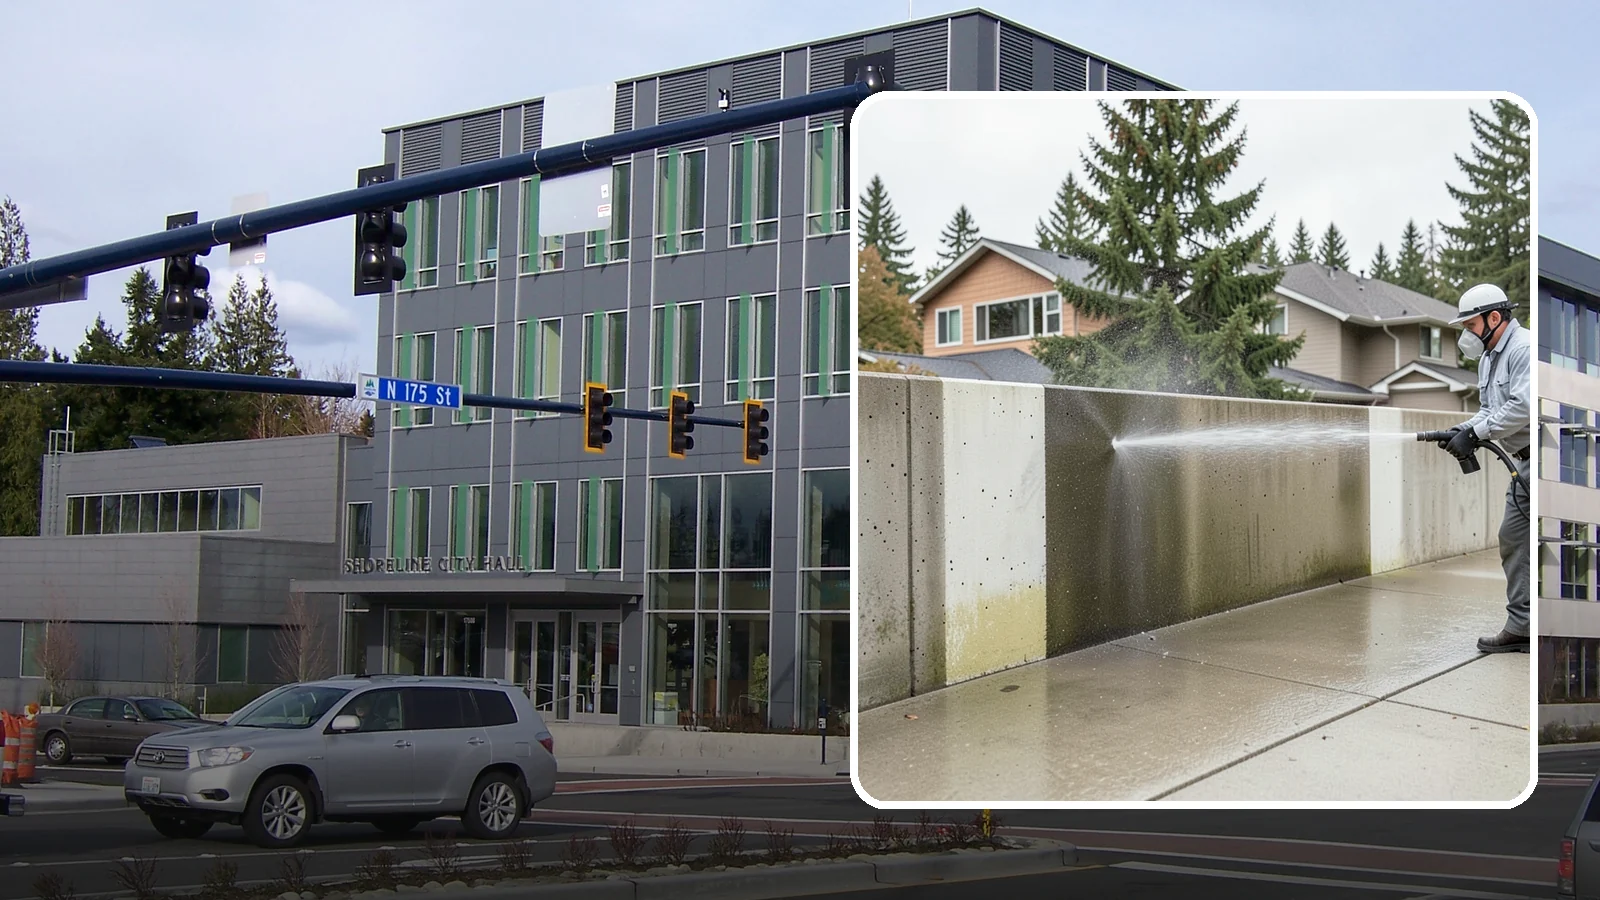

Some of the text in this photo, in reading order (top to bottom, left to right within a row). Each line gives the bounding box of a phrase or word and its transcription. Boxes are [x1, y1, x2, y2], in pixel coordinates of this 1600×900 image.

[387, 380, 452, 406] N 175 St
[344, 555, 526, 574] SHORELINE CITY HALL
